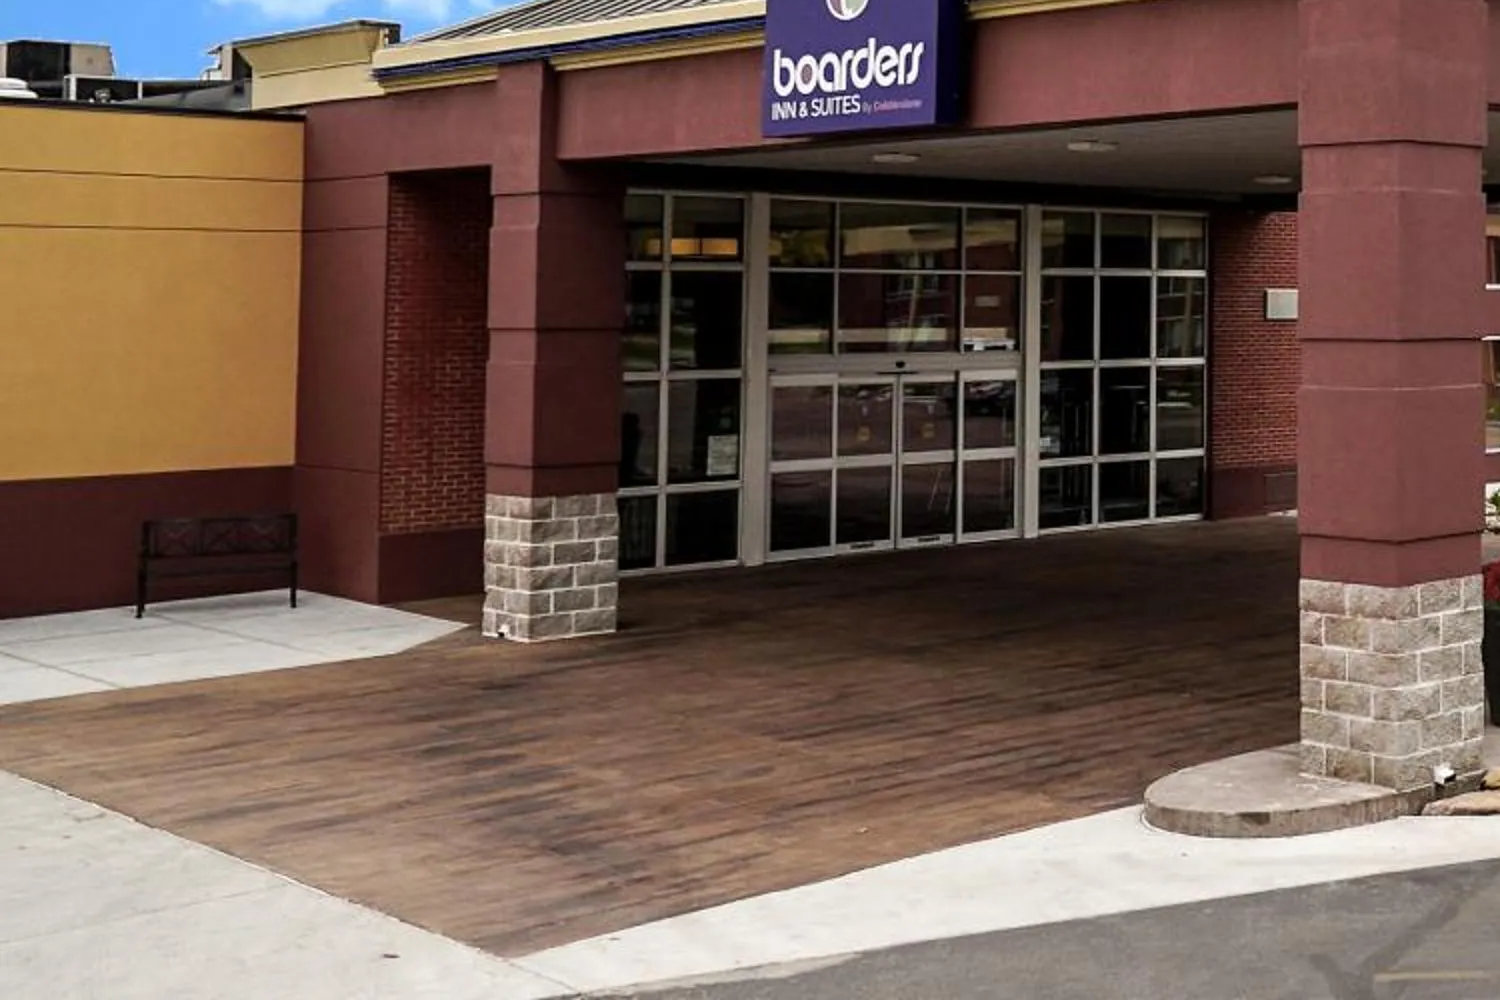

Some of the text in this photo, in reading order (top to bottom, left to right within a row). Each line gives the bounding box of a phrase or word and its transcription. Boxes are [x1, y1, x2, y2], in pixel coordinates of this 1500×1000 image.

[773, 37, 925, 97] boarders
[771, 102, 797, 120] INN
[799, 101, 808, 118] &
[811, 94, 860, 117] SUITES
